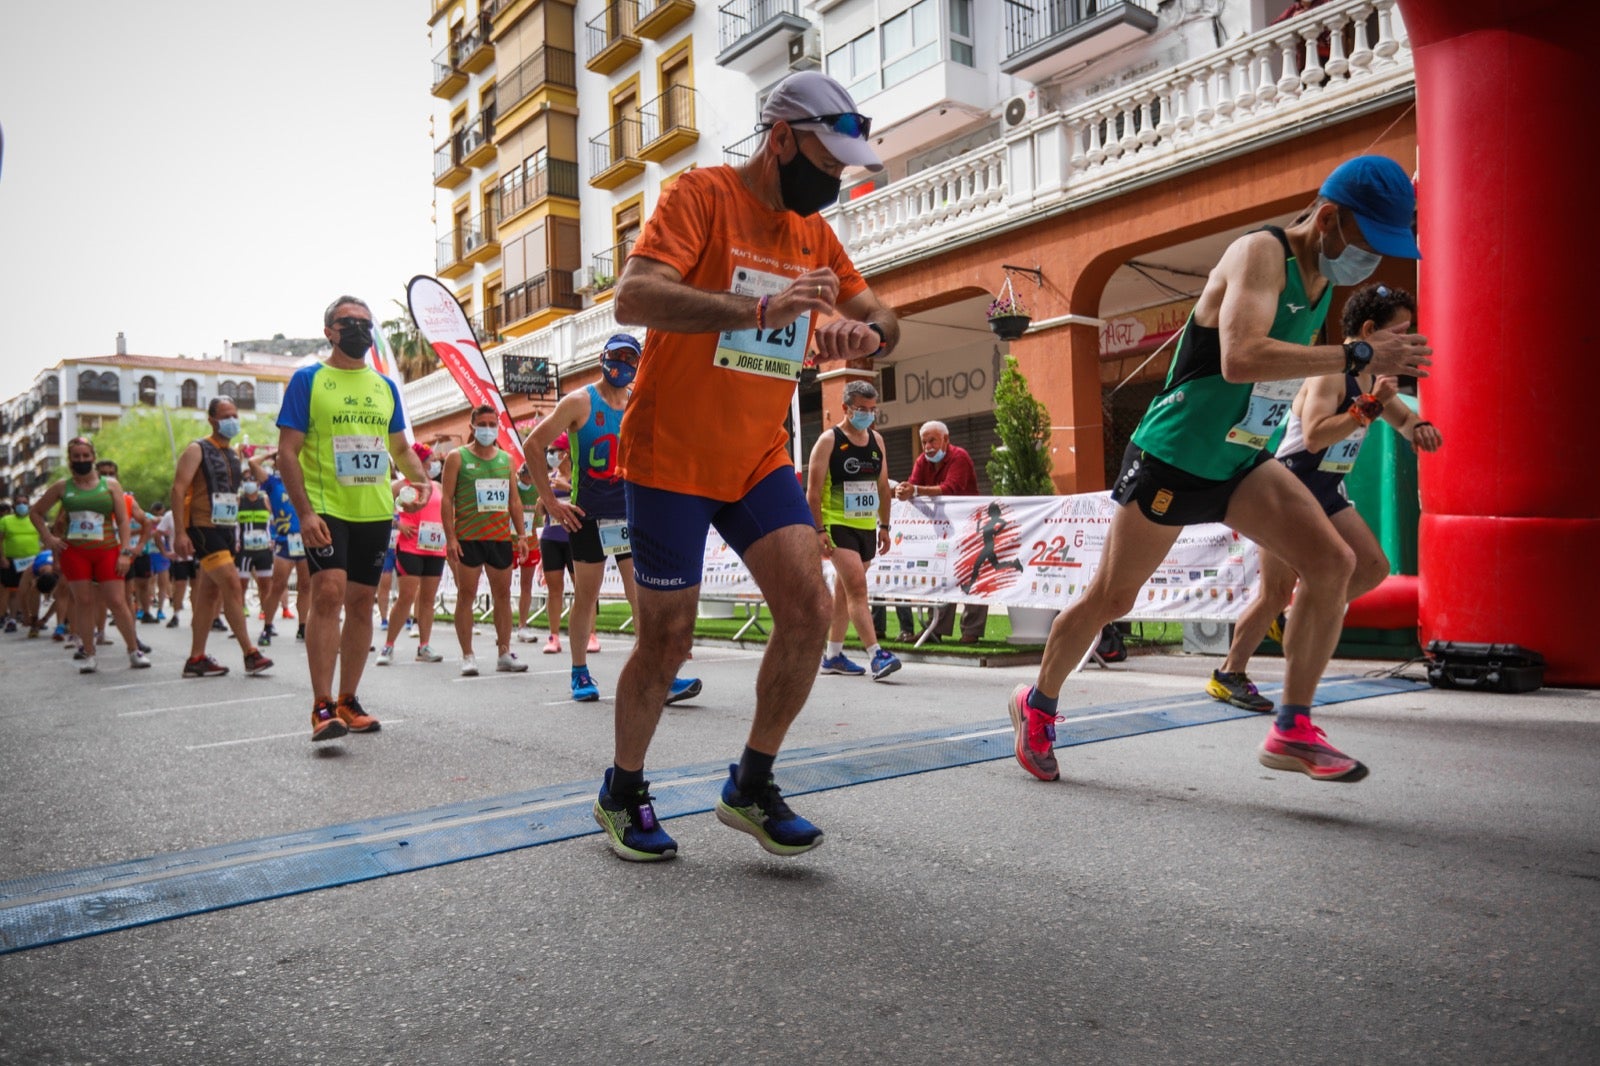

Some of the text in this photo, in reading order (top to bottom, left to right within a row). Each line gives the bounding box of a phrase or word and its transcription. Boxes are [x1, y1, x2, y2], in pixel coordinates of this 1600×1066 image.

[736, 354, 791, 376] JORGE MANUEL
[904, 368, 986, 405] Dilargo
[332, 415, 388, 426] MARACENA
[351, 454, 380, 470] 137
[486, 491, 505, 501] 219
[855, 495, 874, 507] 180
[430, 533, 441, 543] 51
[641, 573, 687, 586] LURBEL
